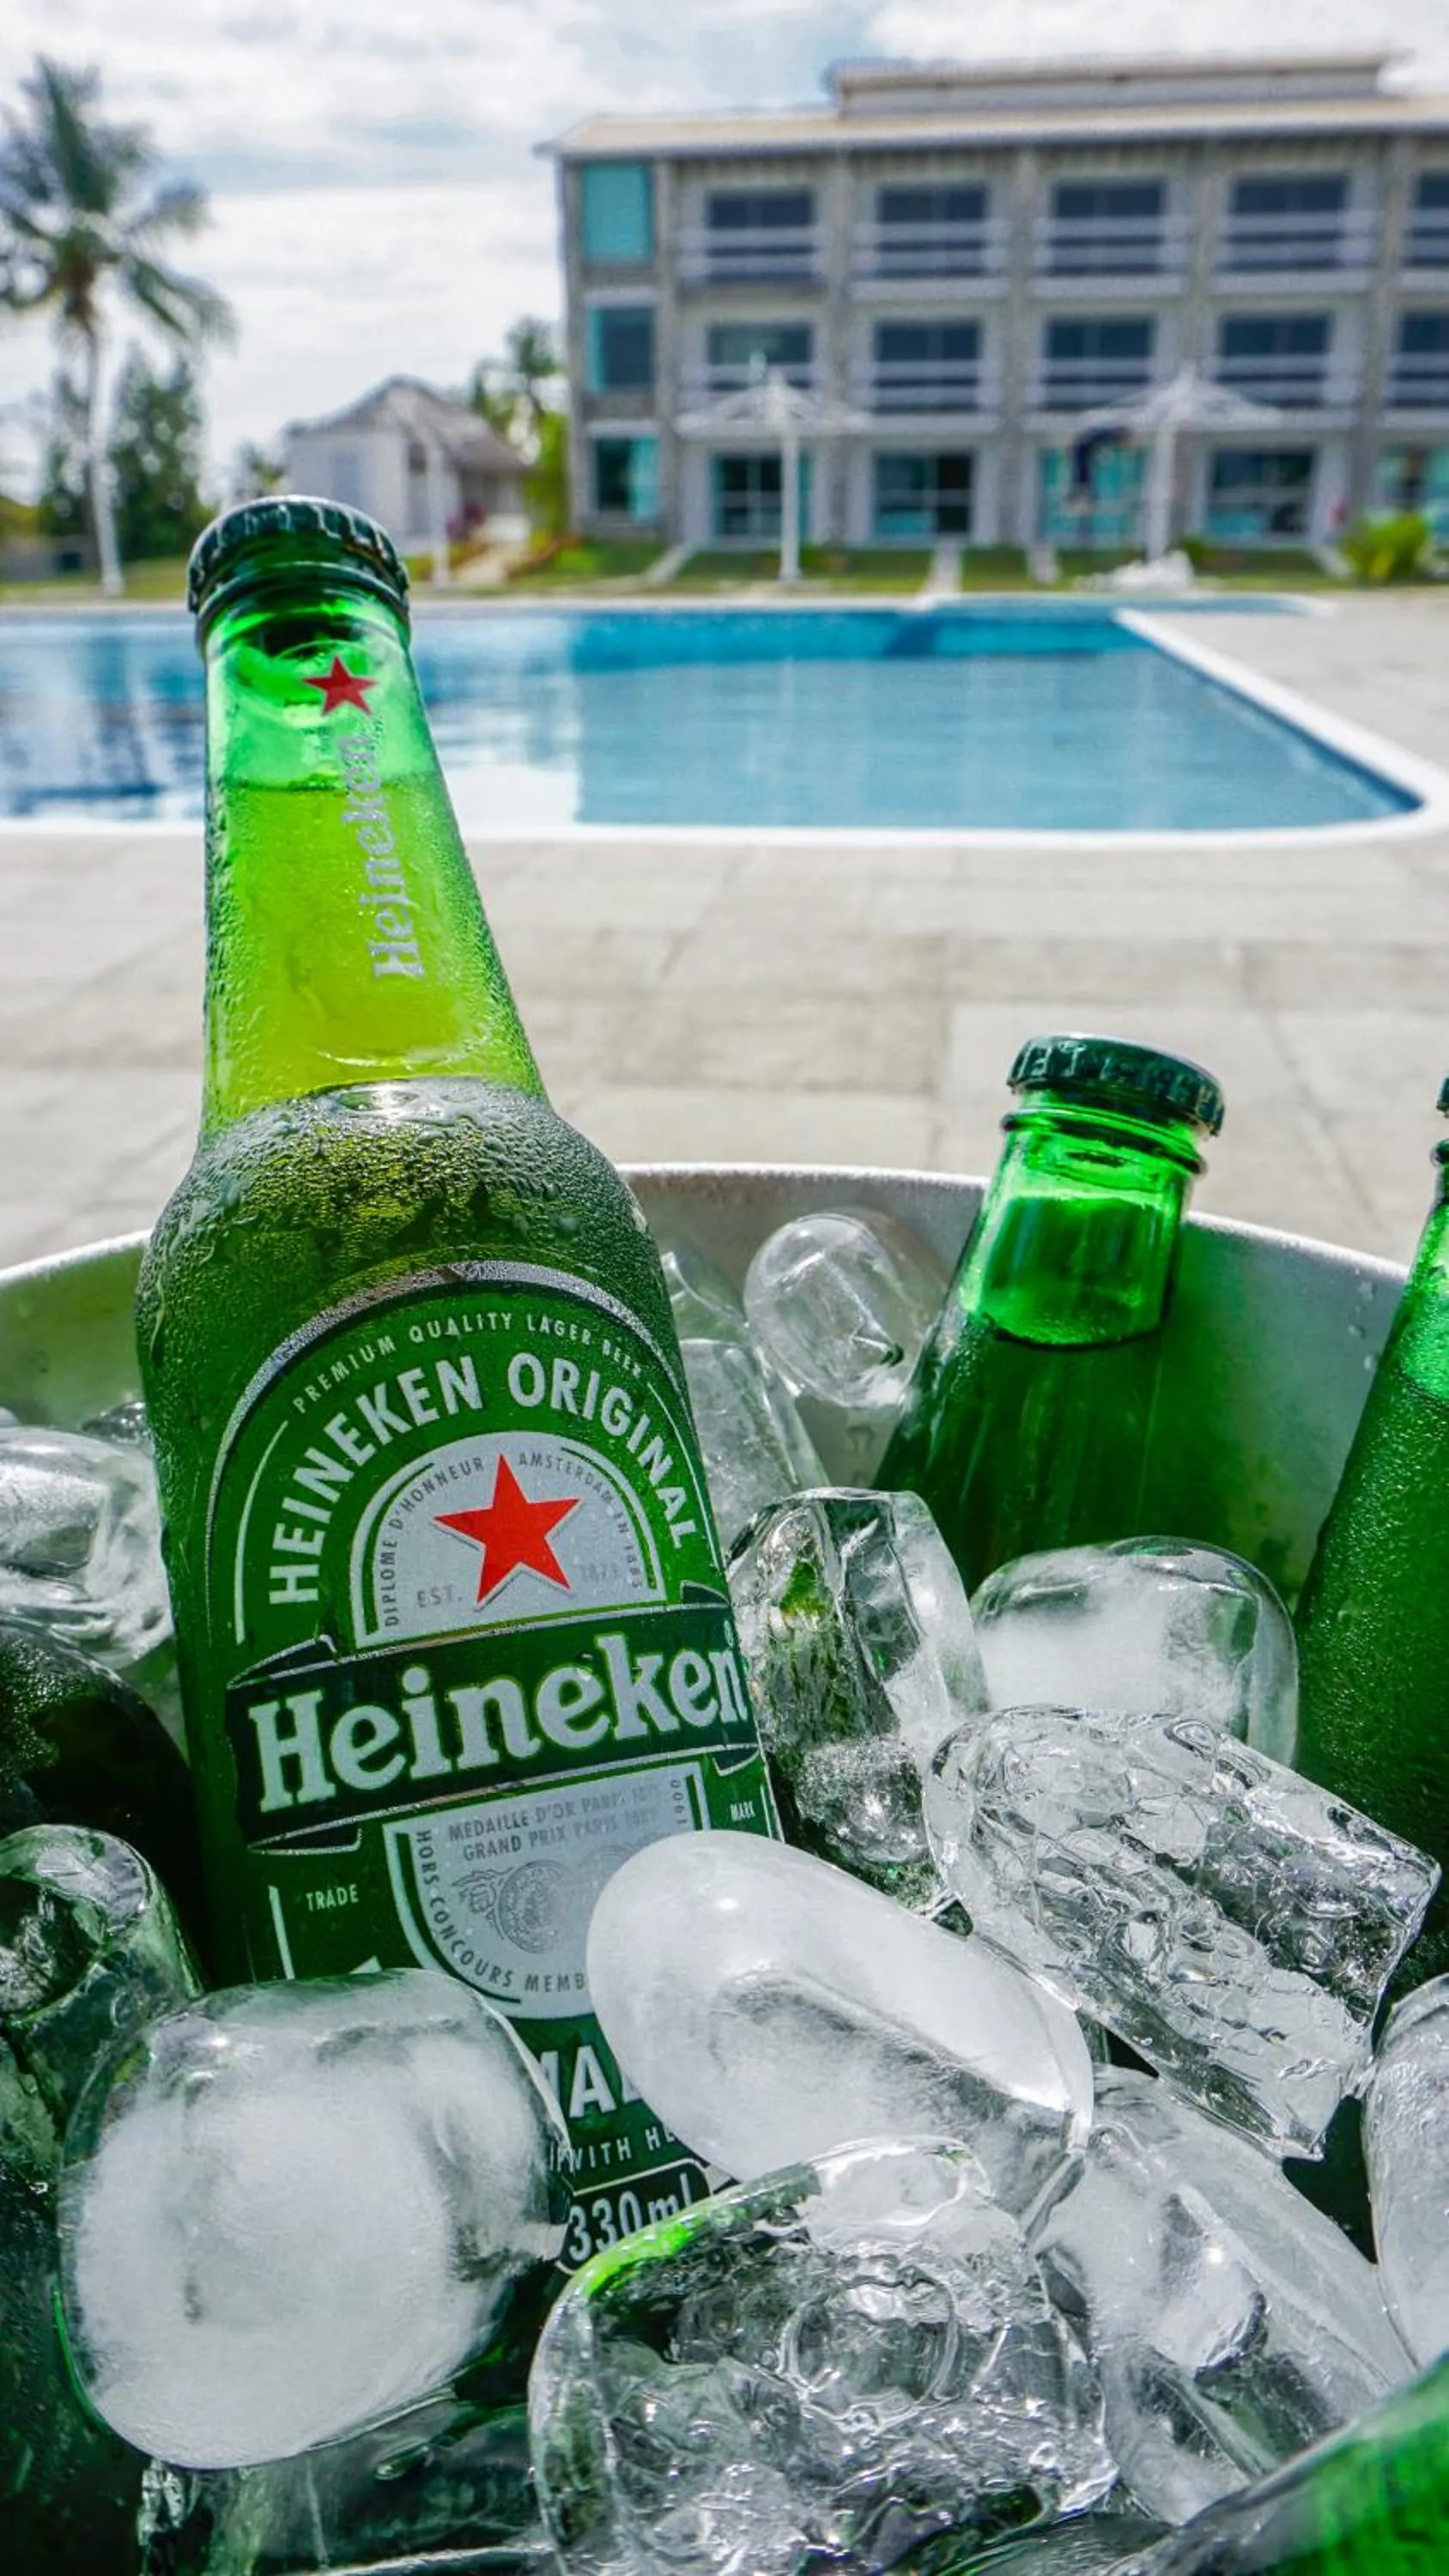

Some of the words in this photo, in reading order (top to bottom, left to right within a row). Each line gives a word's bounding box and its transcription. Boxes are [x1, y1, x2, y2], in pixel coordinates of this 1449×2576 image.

[337, 735, 425, 980] Heineken
[293, 1335, 397, 1414] PREMIUM
[409, 1312, 513, 1344] QUALITY
[526, 1313, 592, 1346] LAGER
[269, 1354, 483, 1605] HEINEKEN
[507, 1352, 698, 1550] ORIGINAL
[389, 1456, 485, 1531] D'HONNEUR
[380, 1540, 400, 1627] DIPLOME
[416, 1584, 464, 1608] EST.
[248, 1631, 749, 1813] Heineken
[449, 1811, 530, 1842] MEDAILLE
[464, 1834, 522, 1862] GRAND
[528, 1823, 568, 1846] PRIX
[731, 1801, 756, 1822] MARK
[306, 1883, 360, 1911] TRADE
[415, 1829, 440, 1886] HORS
[429, 1896, 514, 1988] CONCOURS
